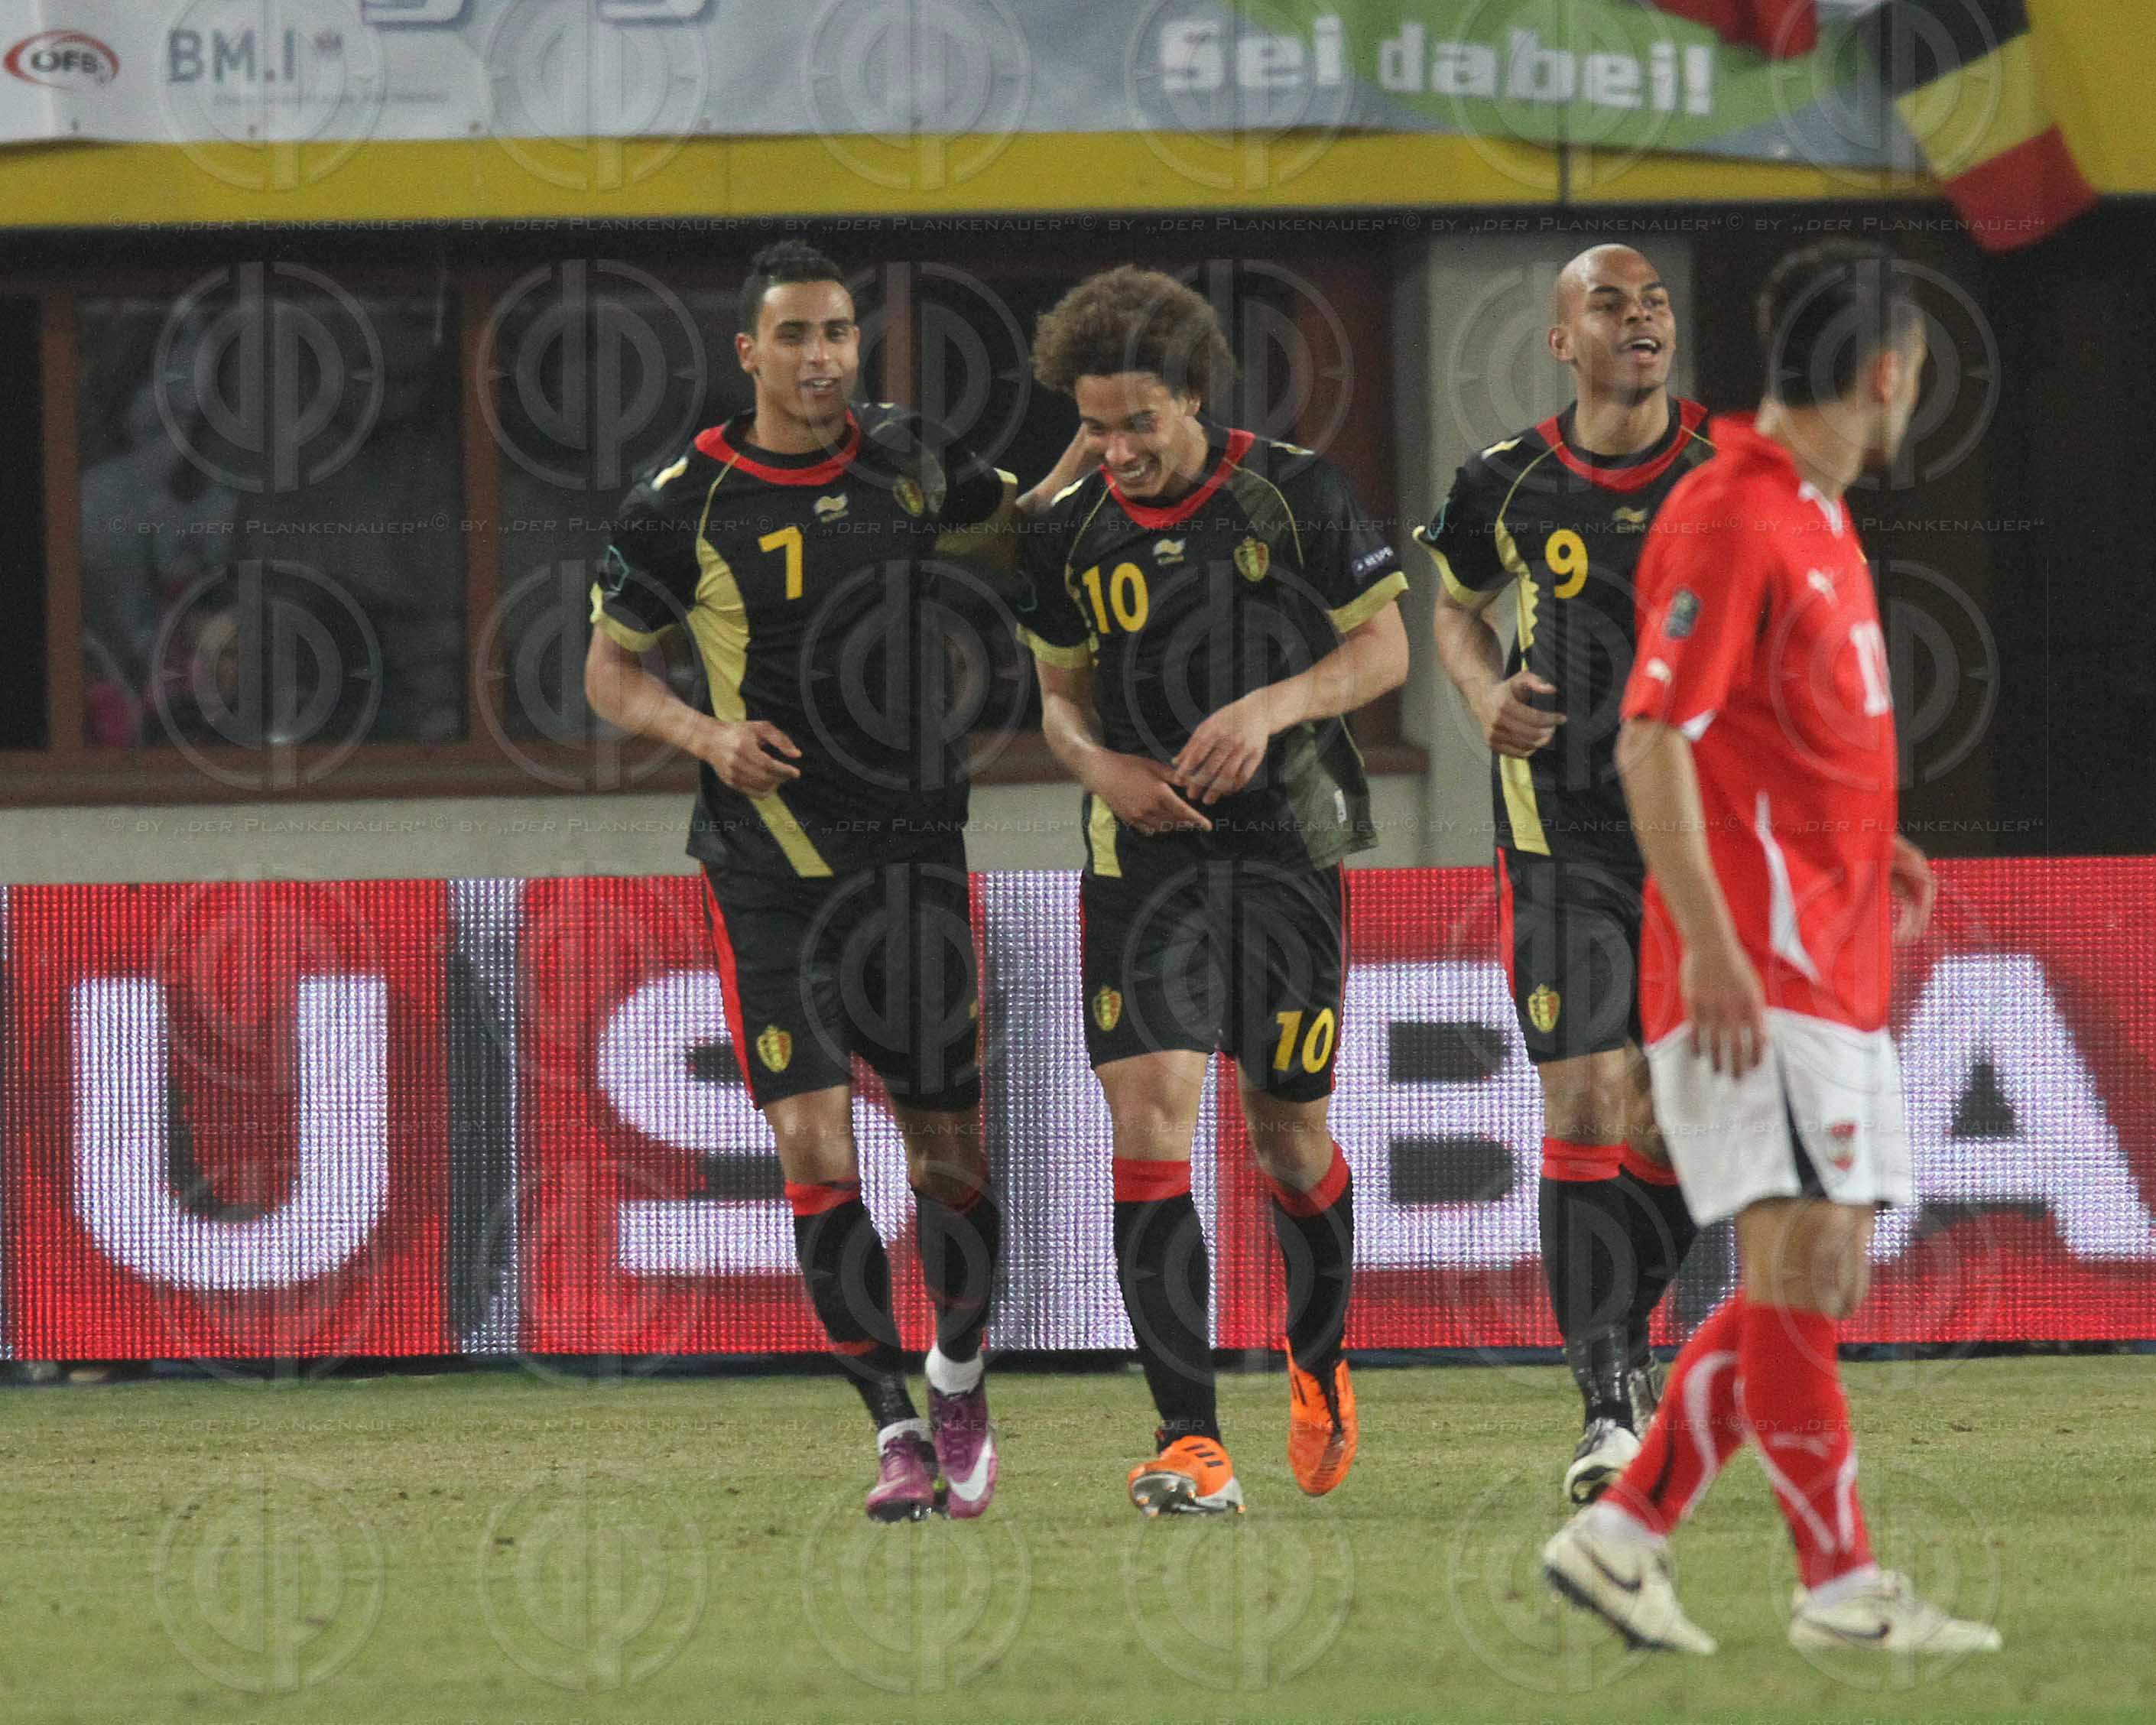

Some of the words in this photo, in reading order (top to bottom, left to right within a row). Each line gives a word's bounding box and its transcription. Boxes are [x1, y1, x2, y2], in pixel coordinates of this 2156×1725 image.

[1162, 14, 1342, 90] Sei
[1379, 23, 1713, 115] dabei!
[758, 526, 804, 600] 7
[1082, 562, 1148, 635] 10
[1544, 529, 1589, 599] 9
[1272, 1006, 1336, 1074] 10
